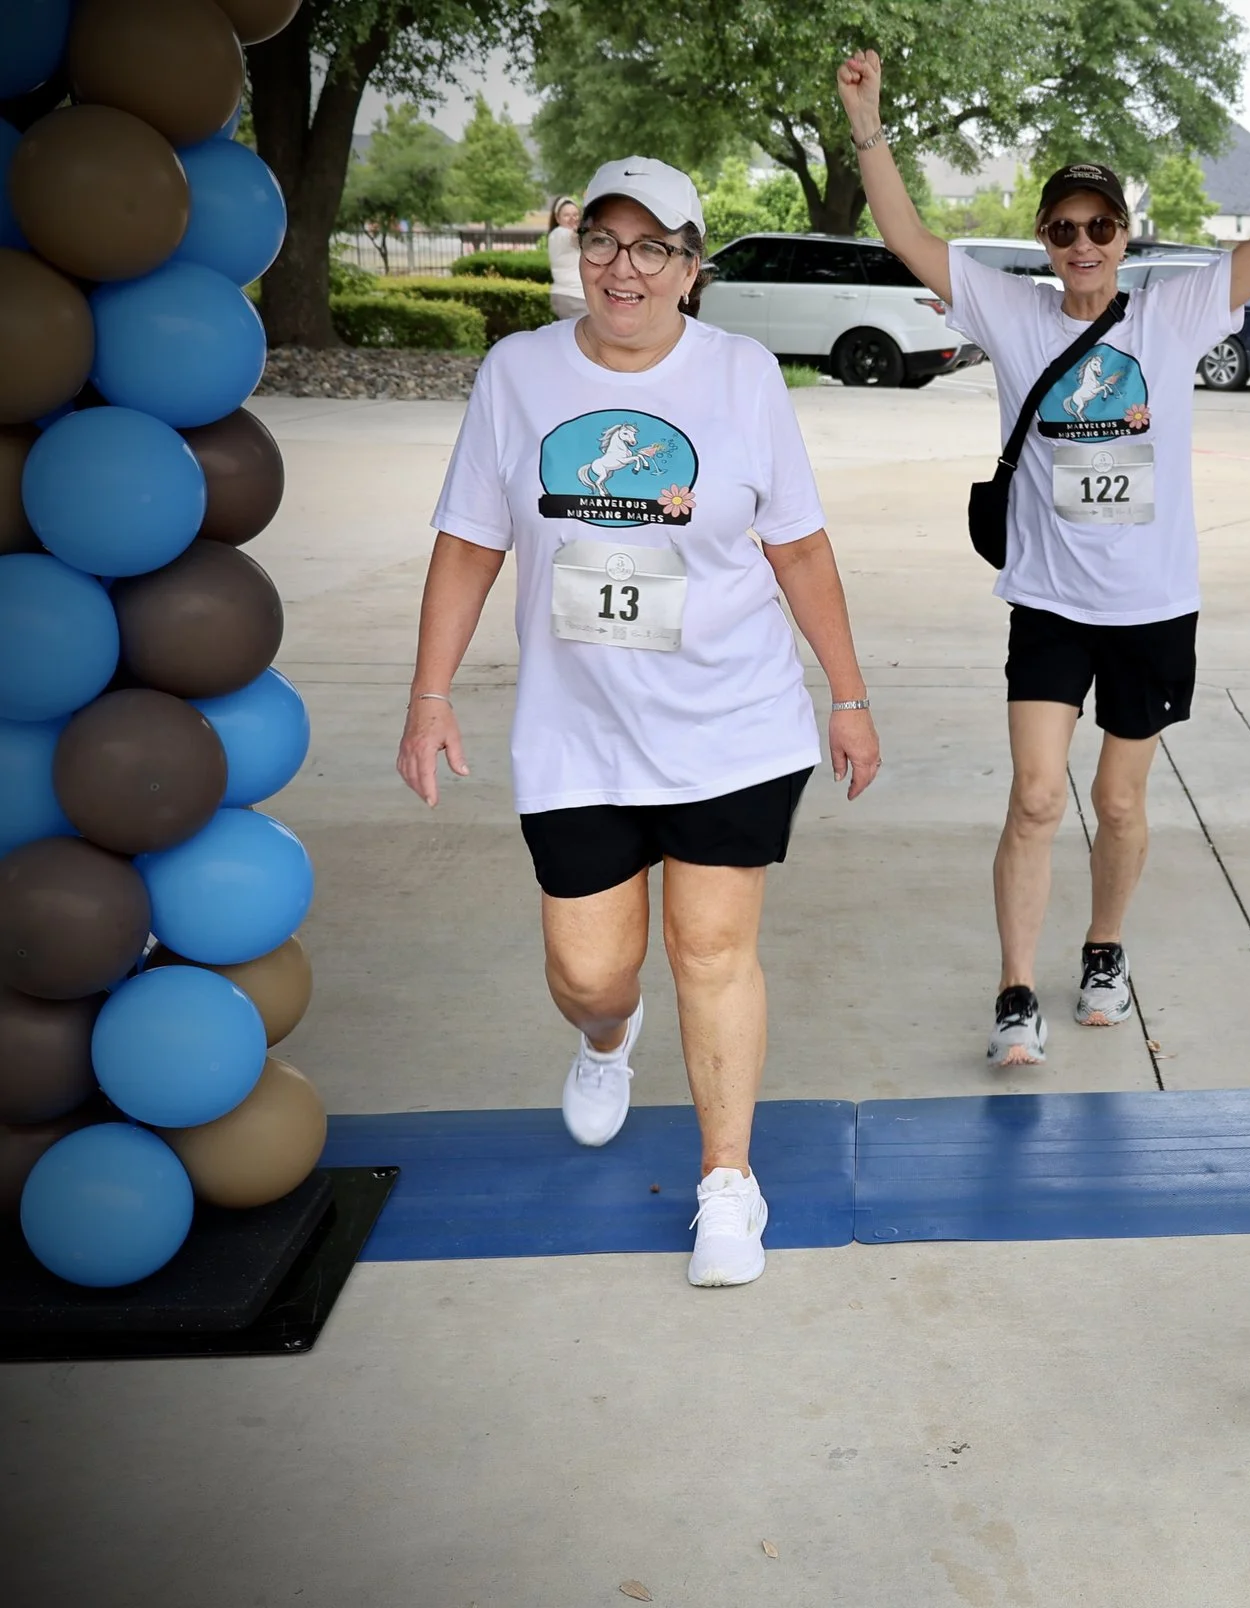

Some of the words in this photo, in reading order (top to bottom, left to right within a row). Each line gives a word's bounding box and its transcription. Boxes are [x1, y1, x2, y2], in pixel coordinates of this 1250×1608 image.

[1066, 421, 1118, 430] MARVELOUS
[1058, 430, 1099, 438] MUSTANG
[1102, 428, 1131, 436] MARES
[1080, 474, 1130, 503] 122
[579, 497, 647, 510] MARVELOUS
[566, 509, 622, 519] MUSTANG
[626, 511, 664, 523] MARES
[598, 584, 639, 621] 13
